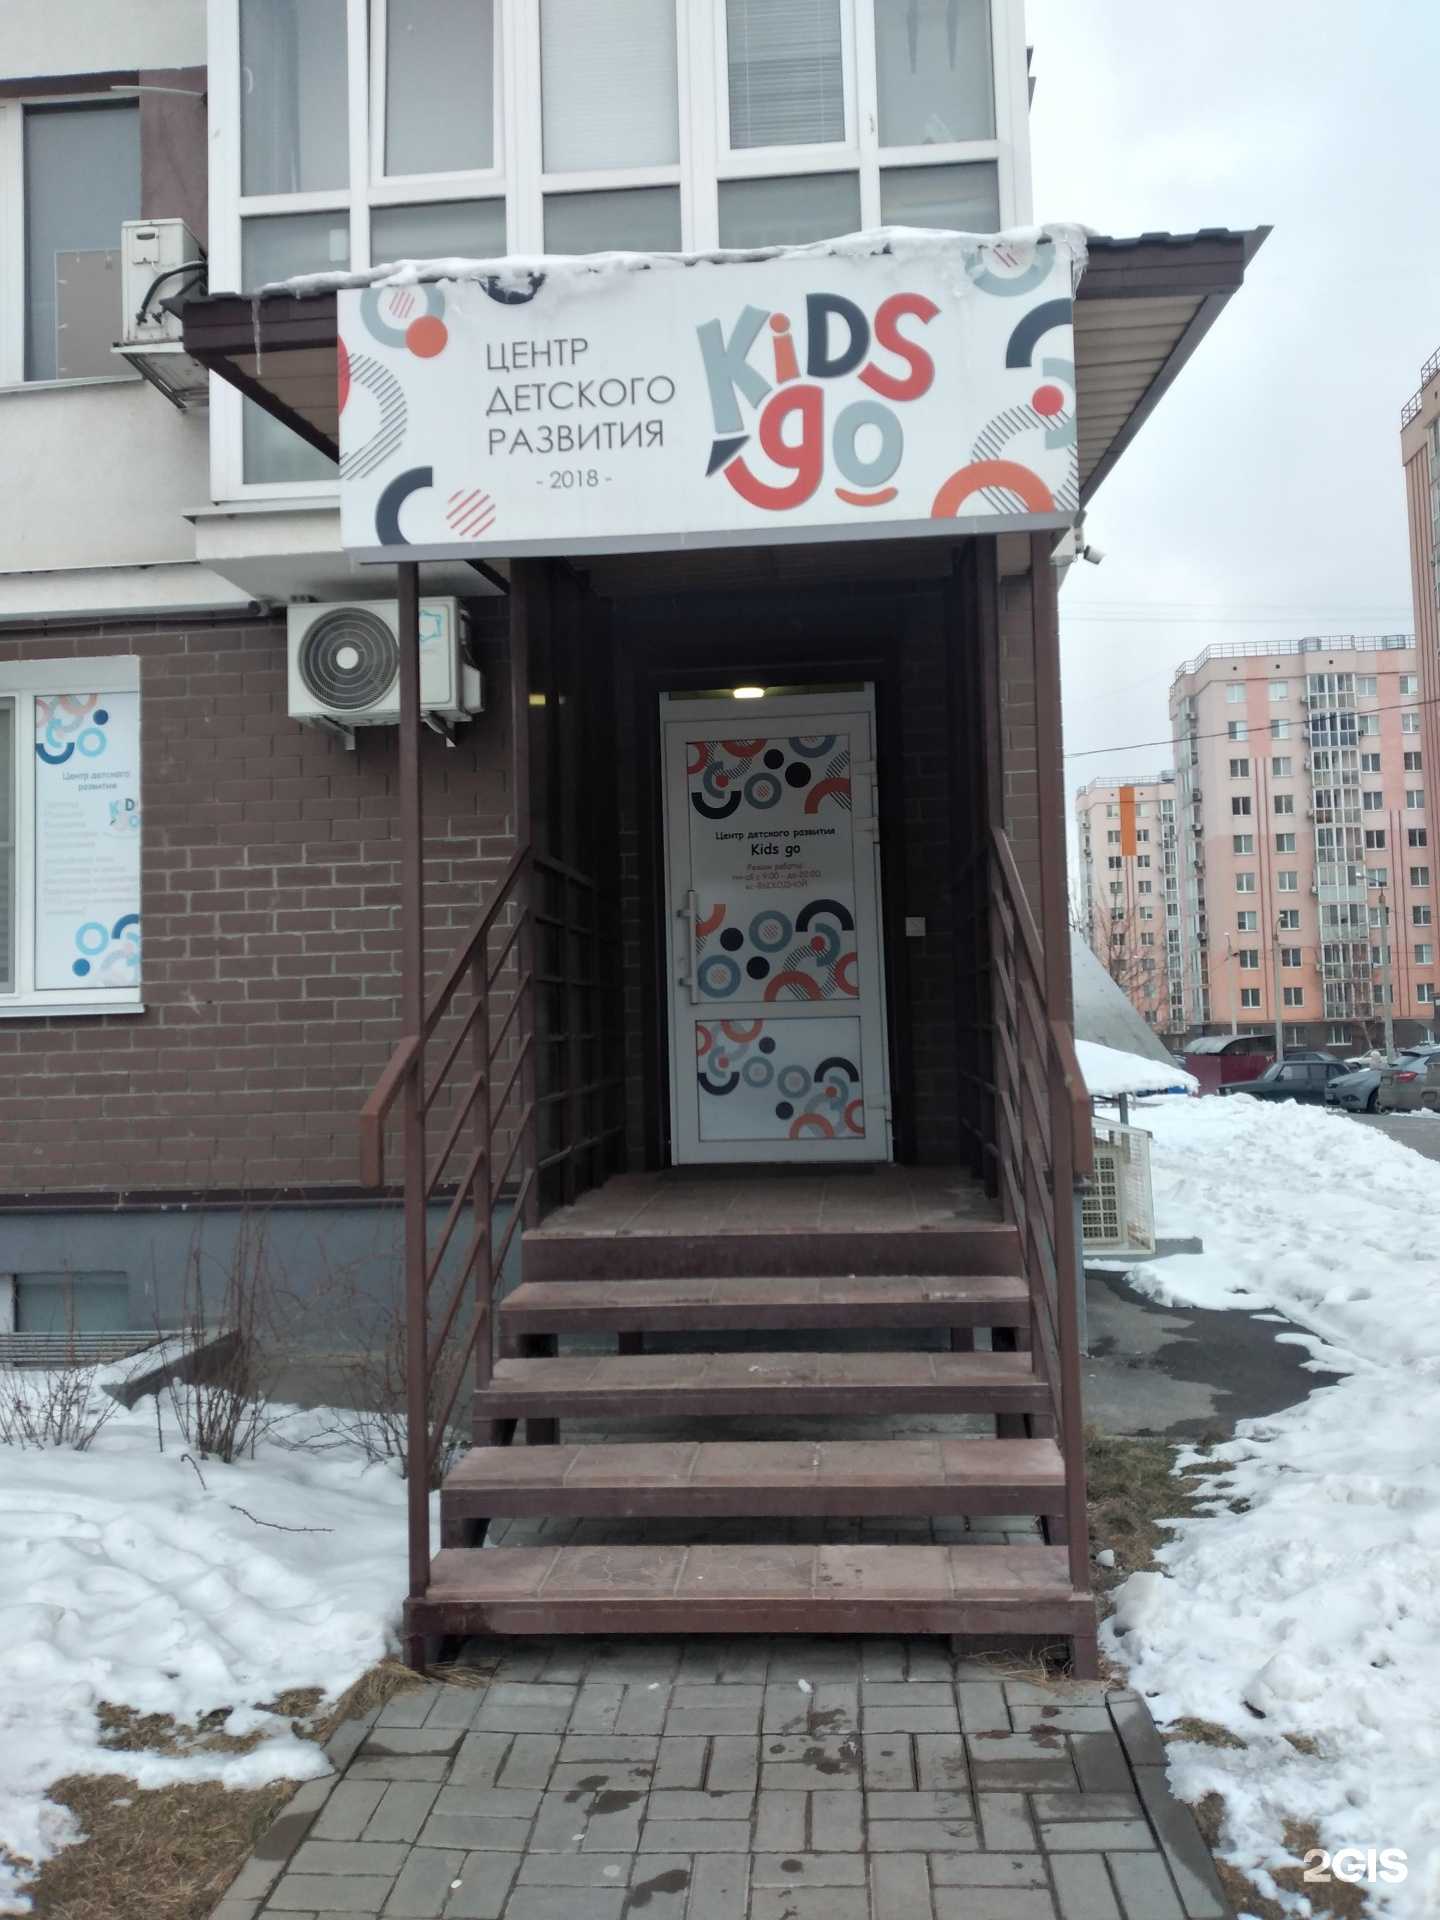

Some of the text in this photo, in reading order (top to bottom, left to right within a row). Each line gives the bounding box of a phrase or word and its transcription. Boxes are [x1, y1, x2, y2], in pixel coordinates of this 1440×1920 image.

[486, 337, 589, 373] ЦЕНТР
[485, 375, 676, 417] ДЕТСКОГО
[488, 419, 664, 456] РАЗВИТИЯ
[722, 383, 904, 511] go
[549, 468, 599, 489] 2018
[715, 832, 744, 841] Центр
[747, 830, 789, 839] детского
[751, 843, 801, 857] Kids go
